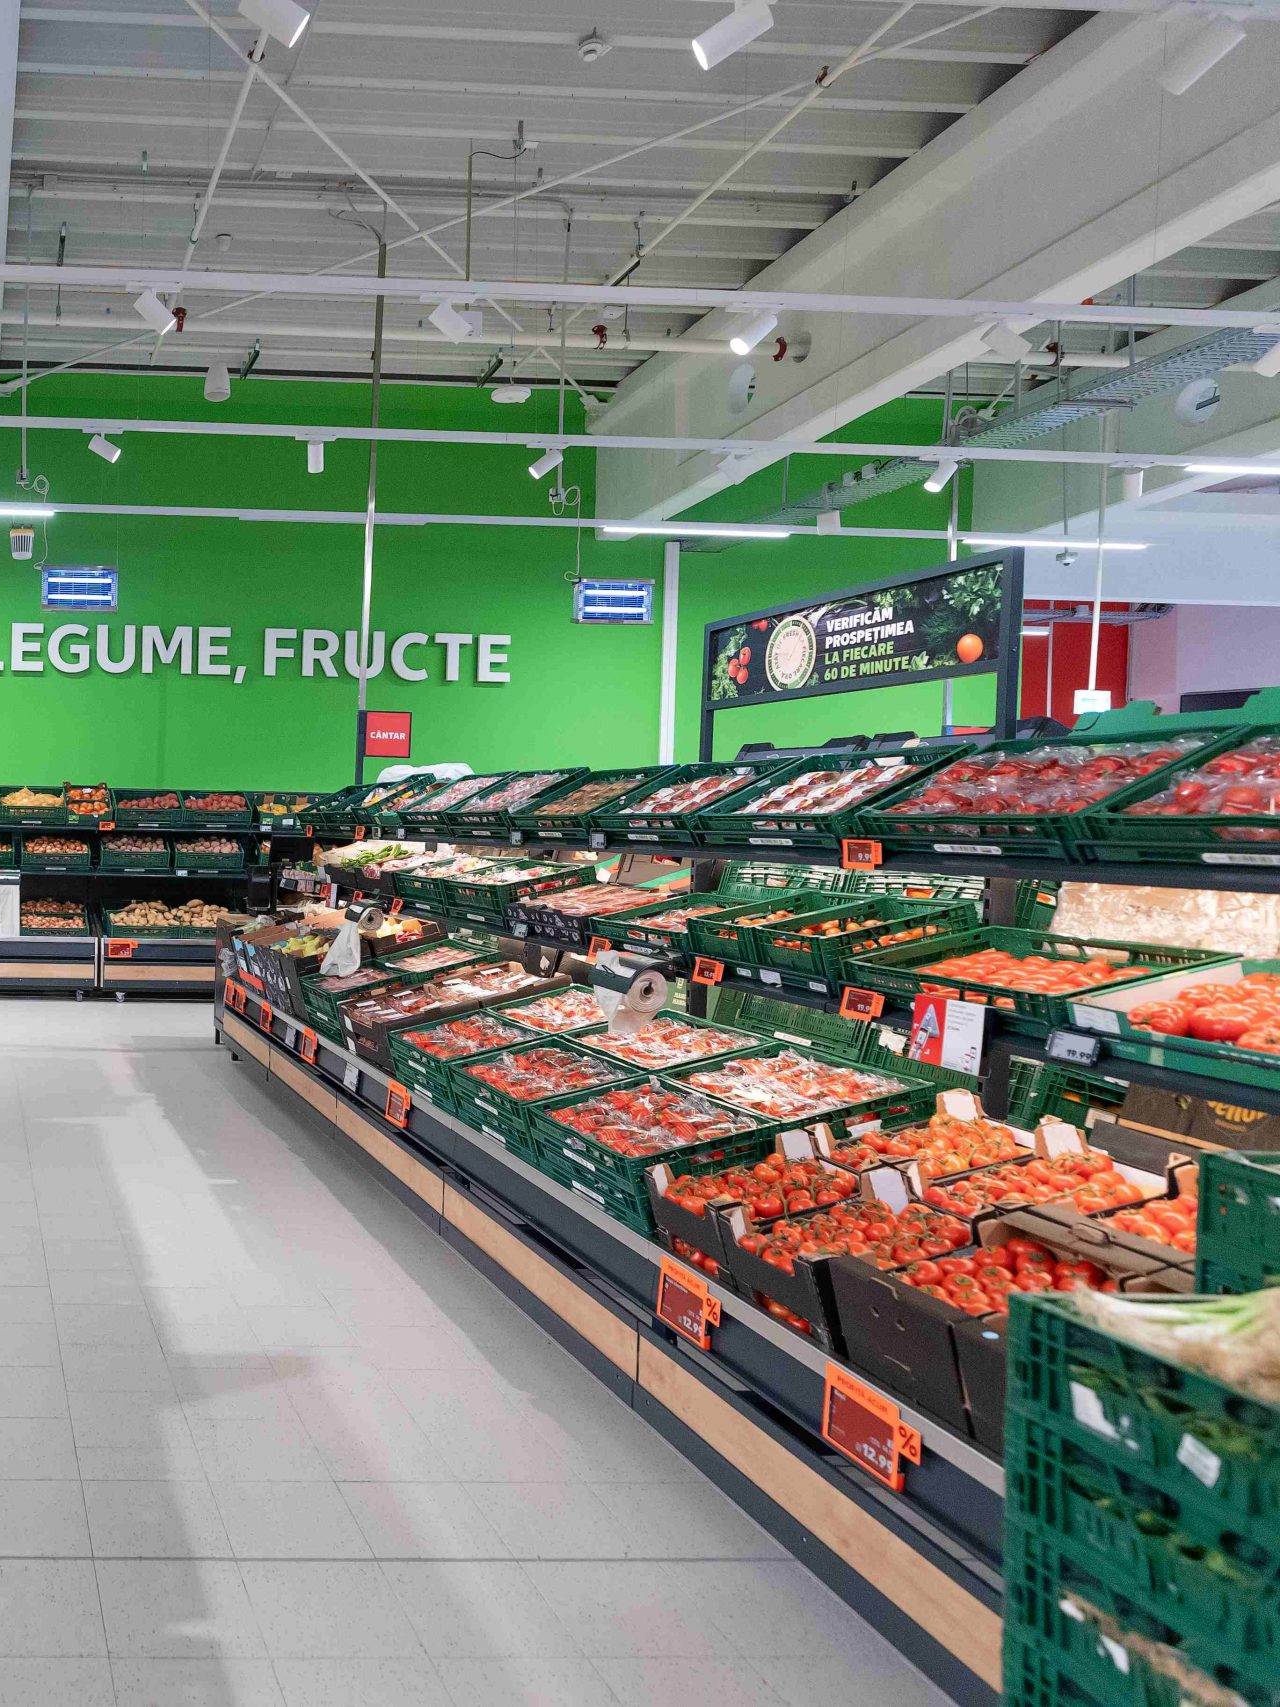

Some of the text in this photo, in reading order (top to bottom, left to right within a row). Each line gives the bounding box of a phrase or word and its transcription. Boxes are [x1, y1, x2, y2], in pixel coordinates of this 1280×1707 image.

[826, 606, 894, 633] VERIFICĂM
[263, 627, 512, 683] FRUCTE
[824, 641, 894, 665] LA FIECARE
[824, 655, 910, 682] 60 DE MINUTE
[370, 729, 406, 740] CÂNTAR
